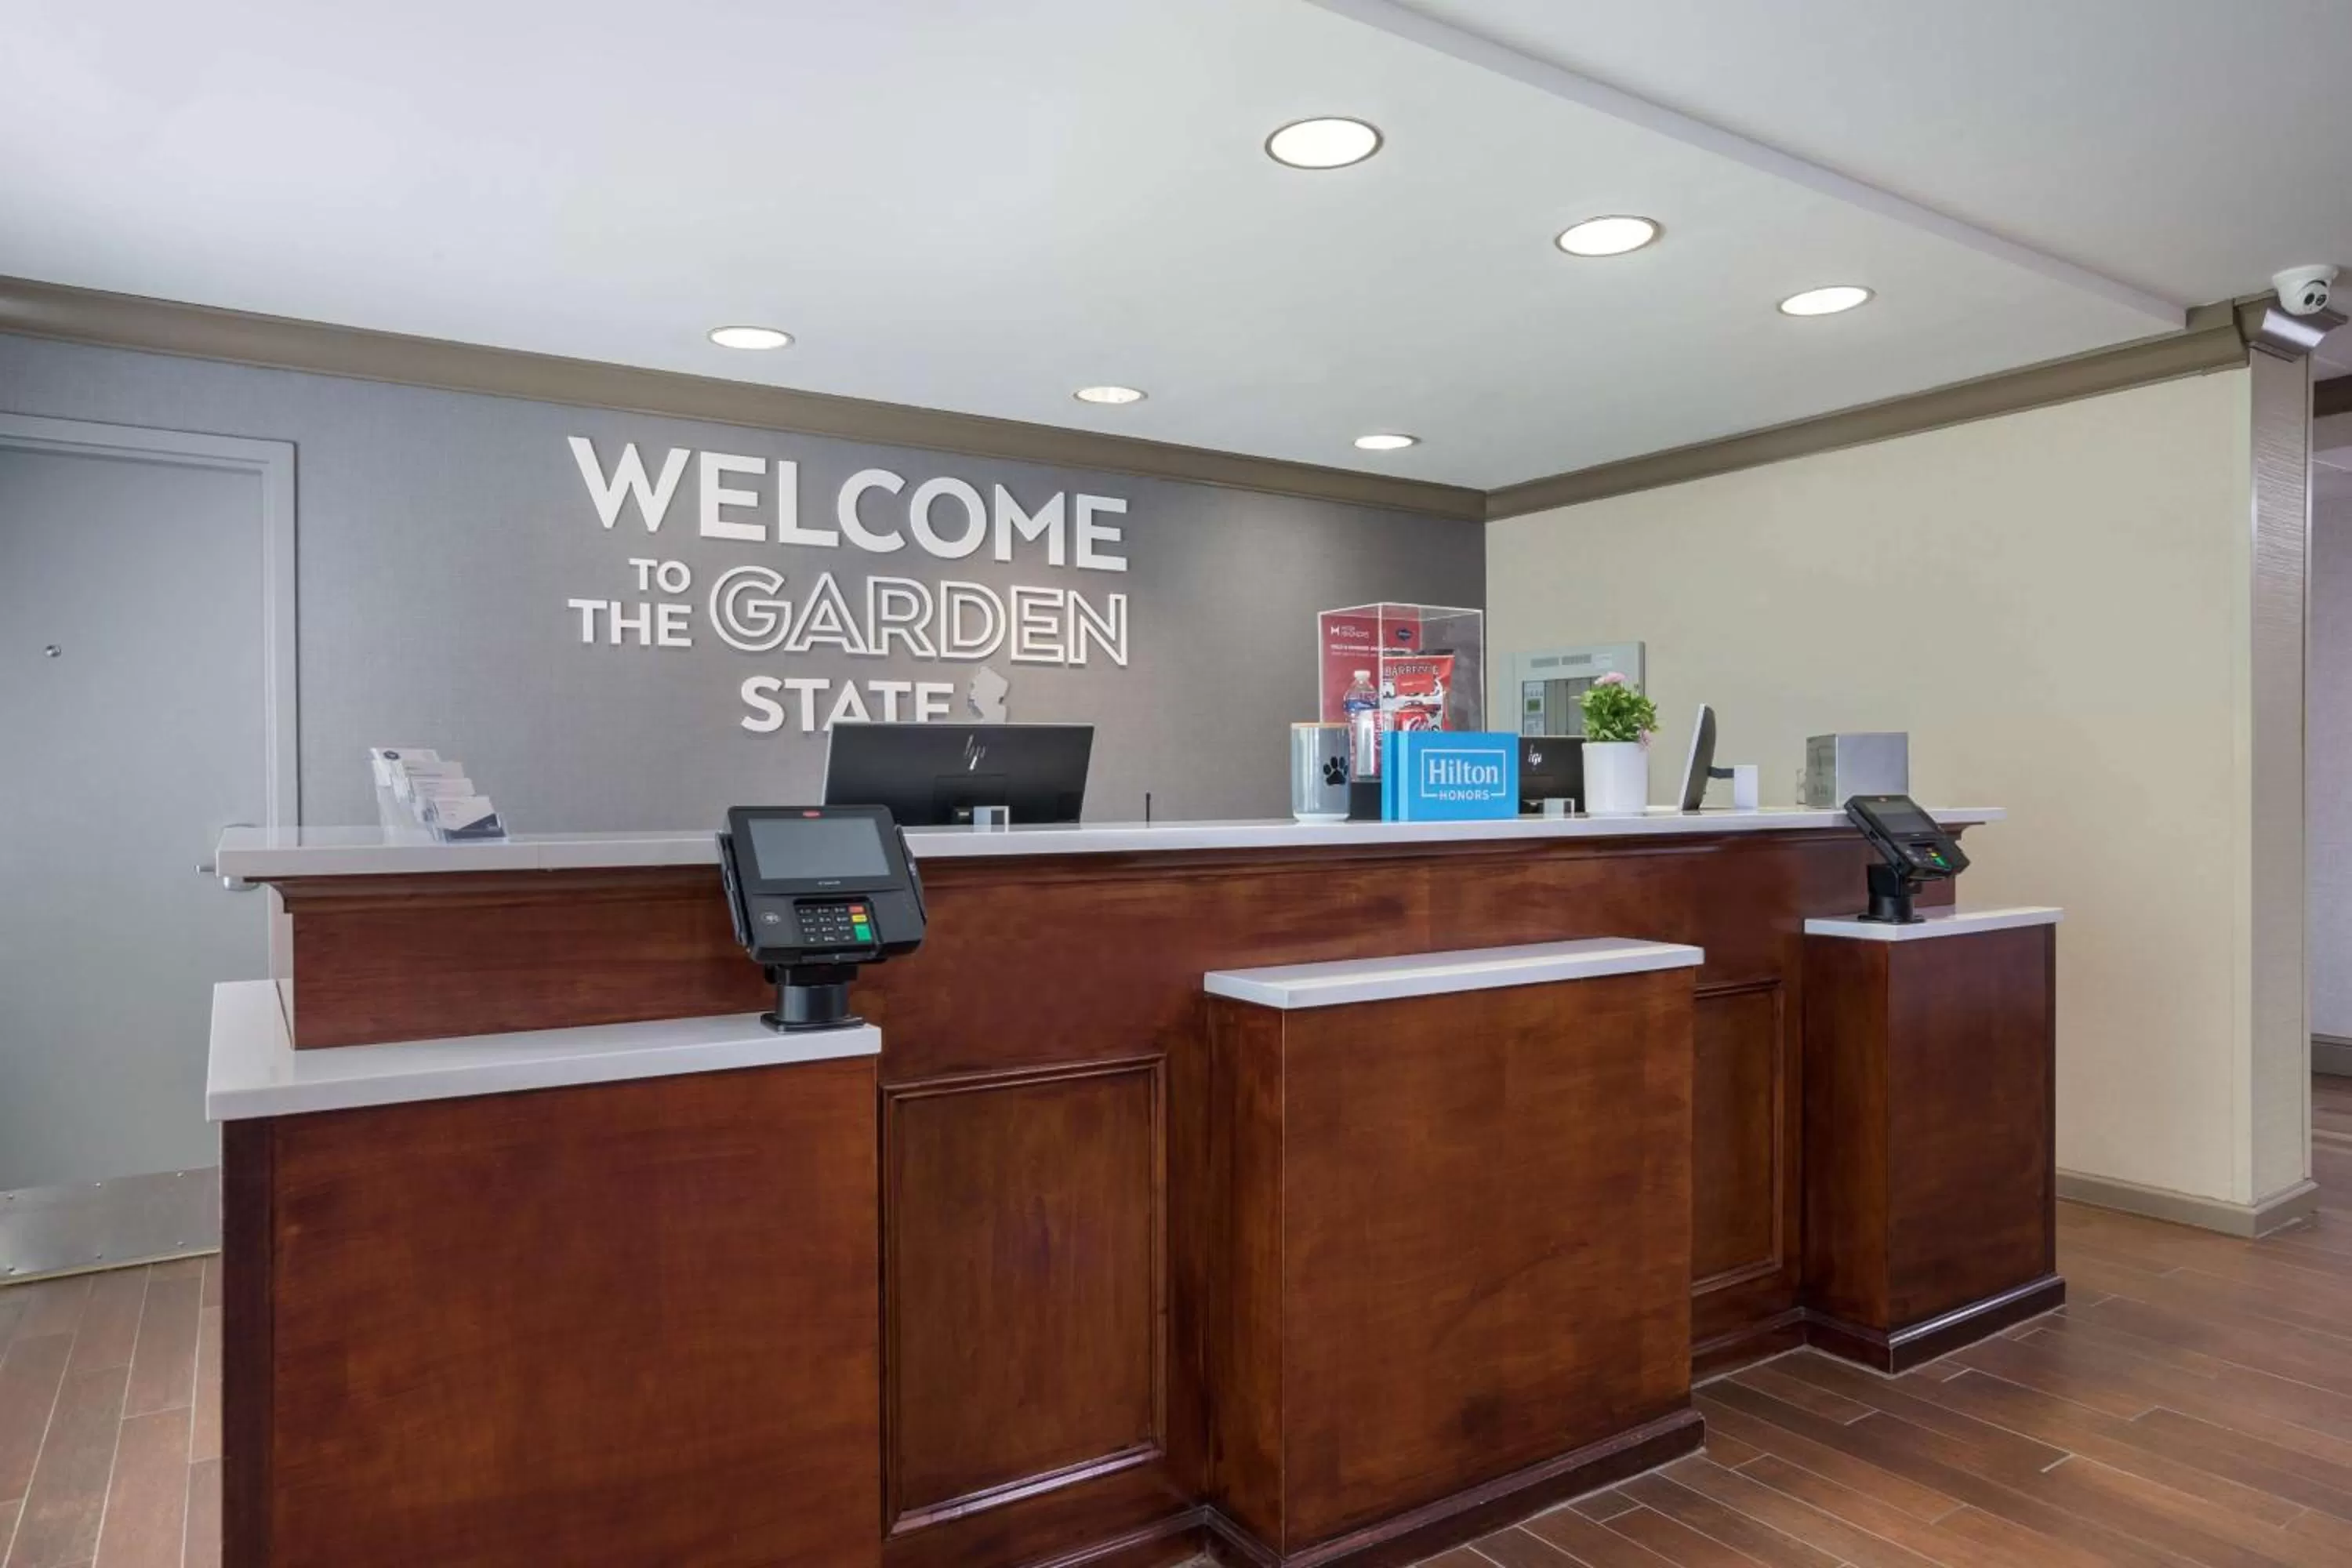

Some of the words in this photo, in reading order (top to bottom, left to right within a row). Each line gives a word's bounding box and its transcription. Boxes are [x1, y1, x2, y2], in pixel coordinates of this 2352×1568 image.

[568, 436, 1128, 572] WELCOME
[629, 557, 691, 593] TO
[568, 598, 692, 647] THE
[710, 565, 1128, 666] GARDEN
[740, 676, 955, 732] STATE
[1428, 758, 1499, 785] Hilton
[1439, 789, 1490, 800] HONORS
